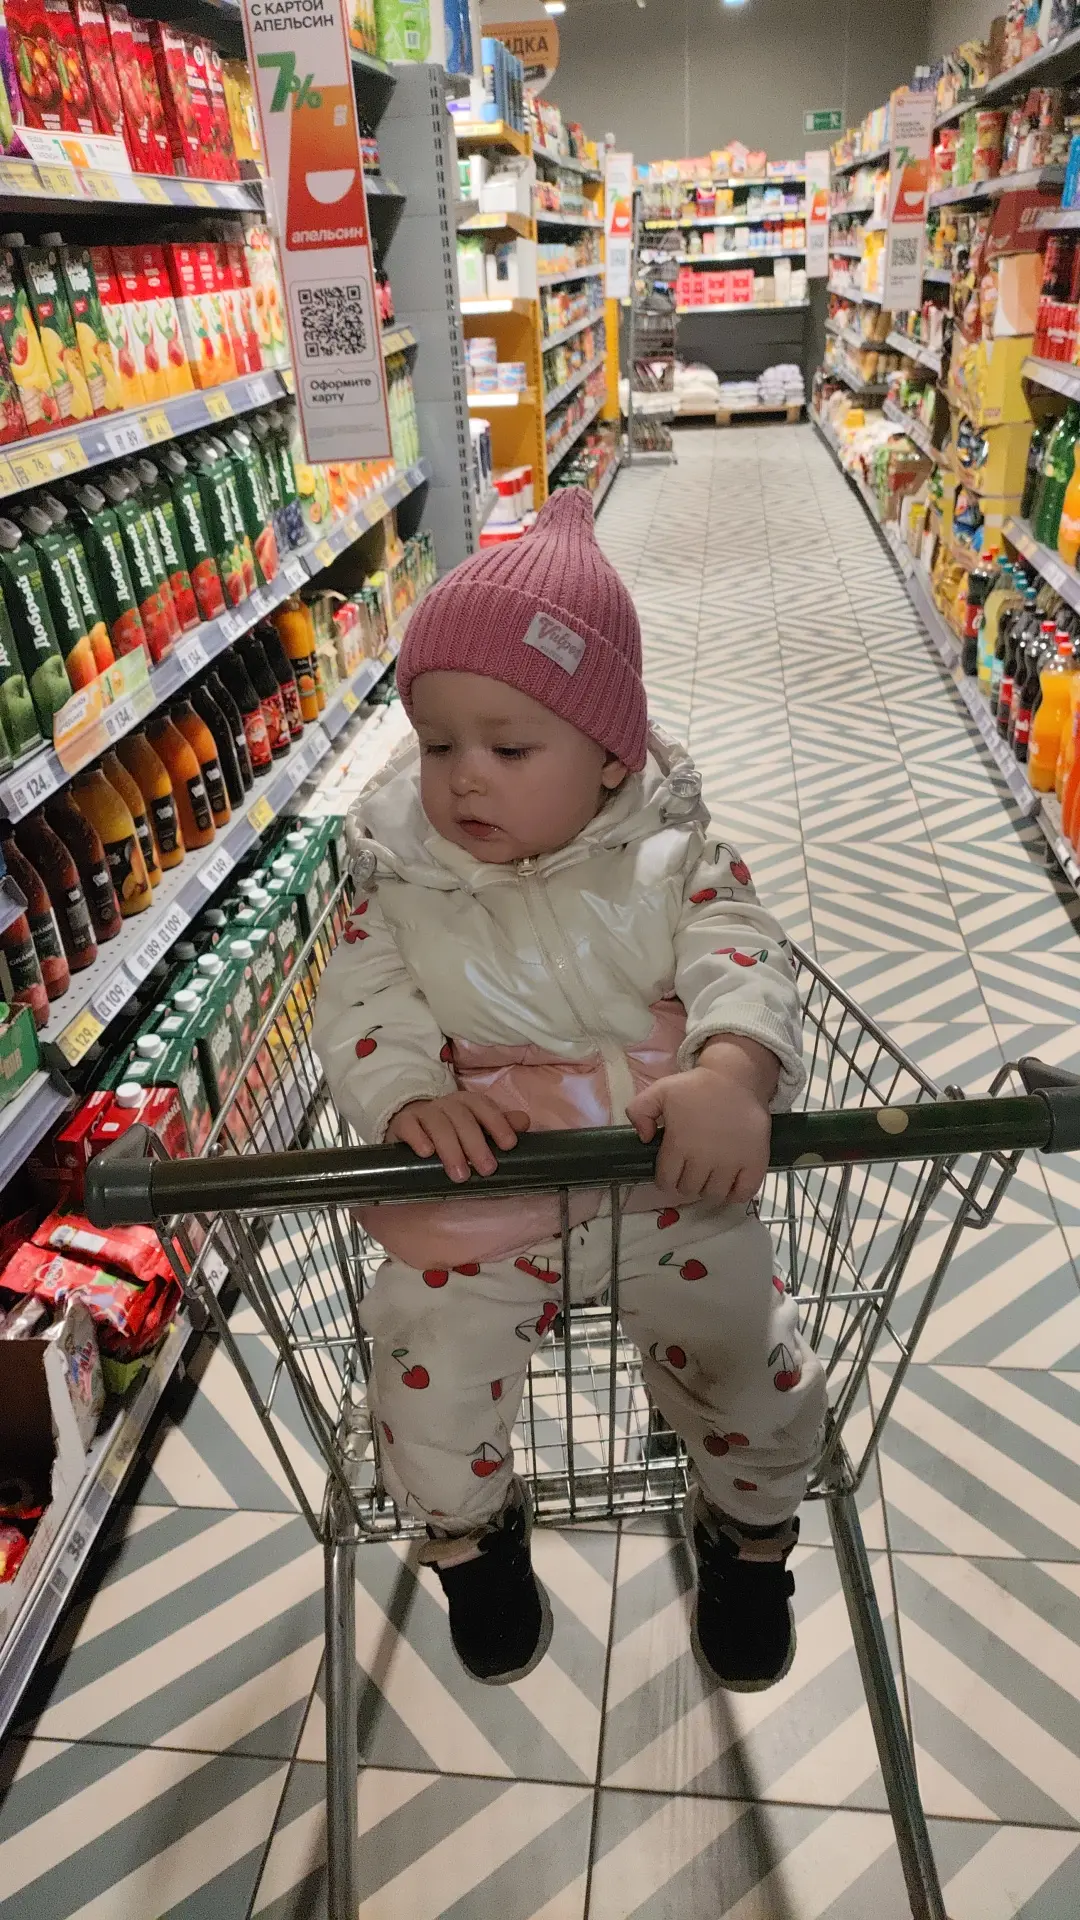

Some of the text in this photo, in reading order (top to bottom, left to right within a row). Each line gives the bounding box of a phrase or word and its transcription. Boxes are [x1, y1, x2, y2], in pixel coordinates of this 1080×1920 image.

[251, 4, 261, 16] С
[254, 14, 334, 32] АПЕЛЬСИН
[257, 51, 322, 113] 7%
[291, 227, 364, 243] апельсин
[310, 378, 372, 391] Оформите
[312, 393, 345, 404] карту
[102, 535, 131, 602] Добрый
[126, 523, 153, 588] Добрый
[51, 559, 81, 631] Добрый
[67, 547, 96, 616] Добрый
[16, 574, 52, 650] Добрый
[26, 774, 48, 799] 124
